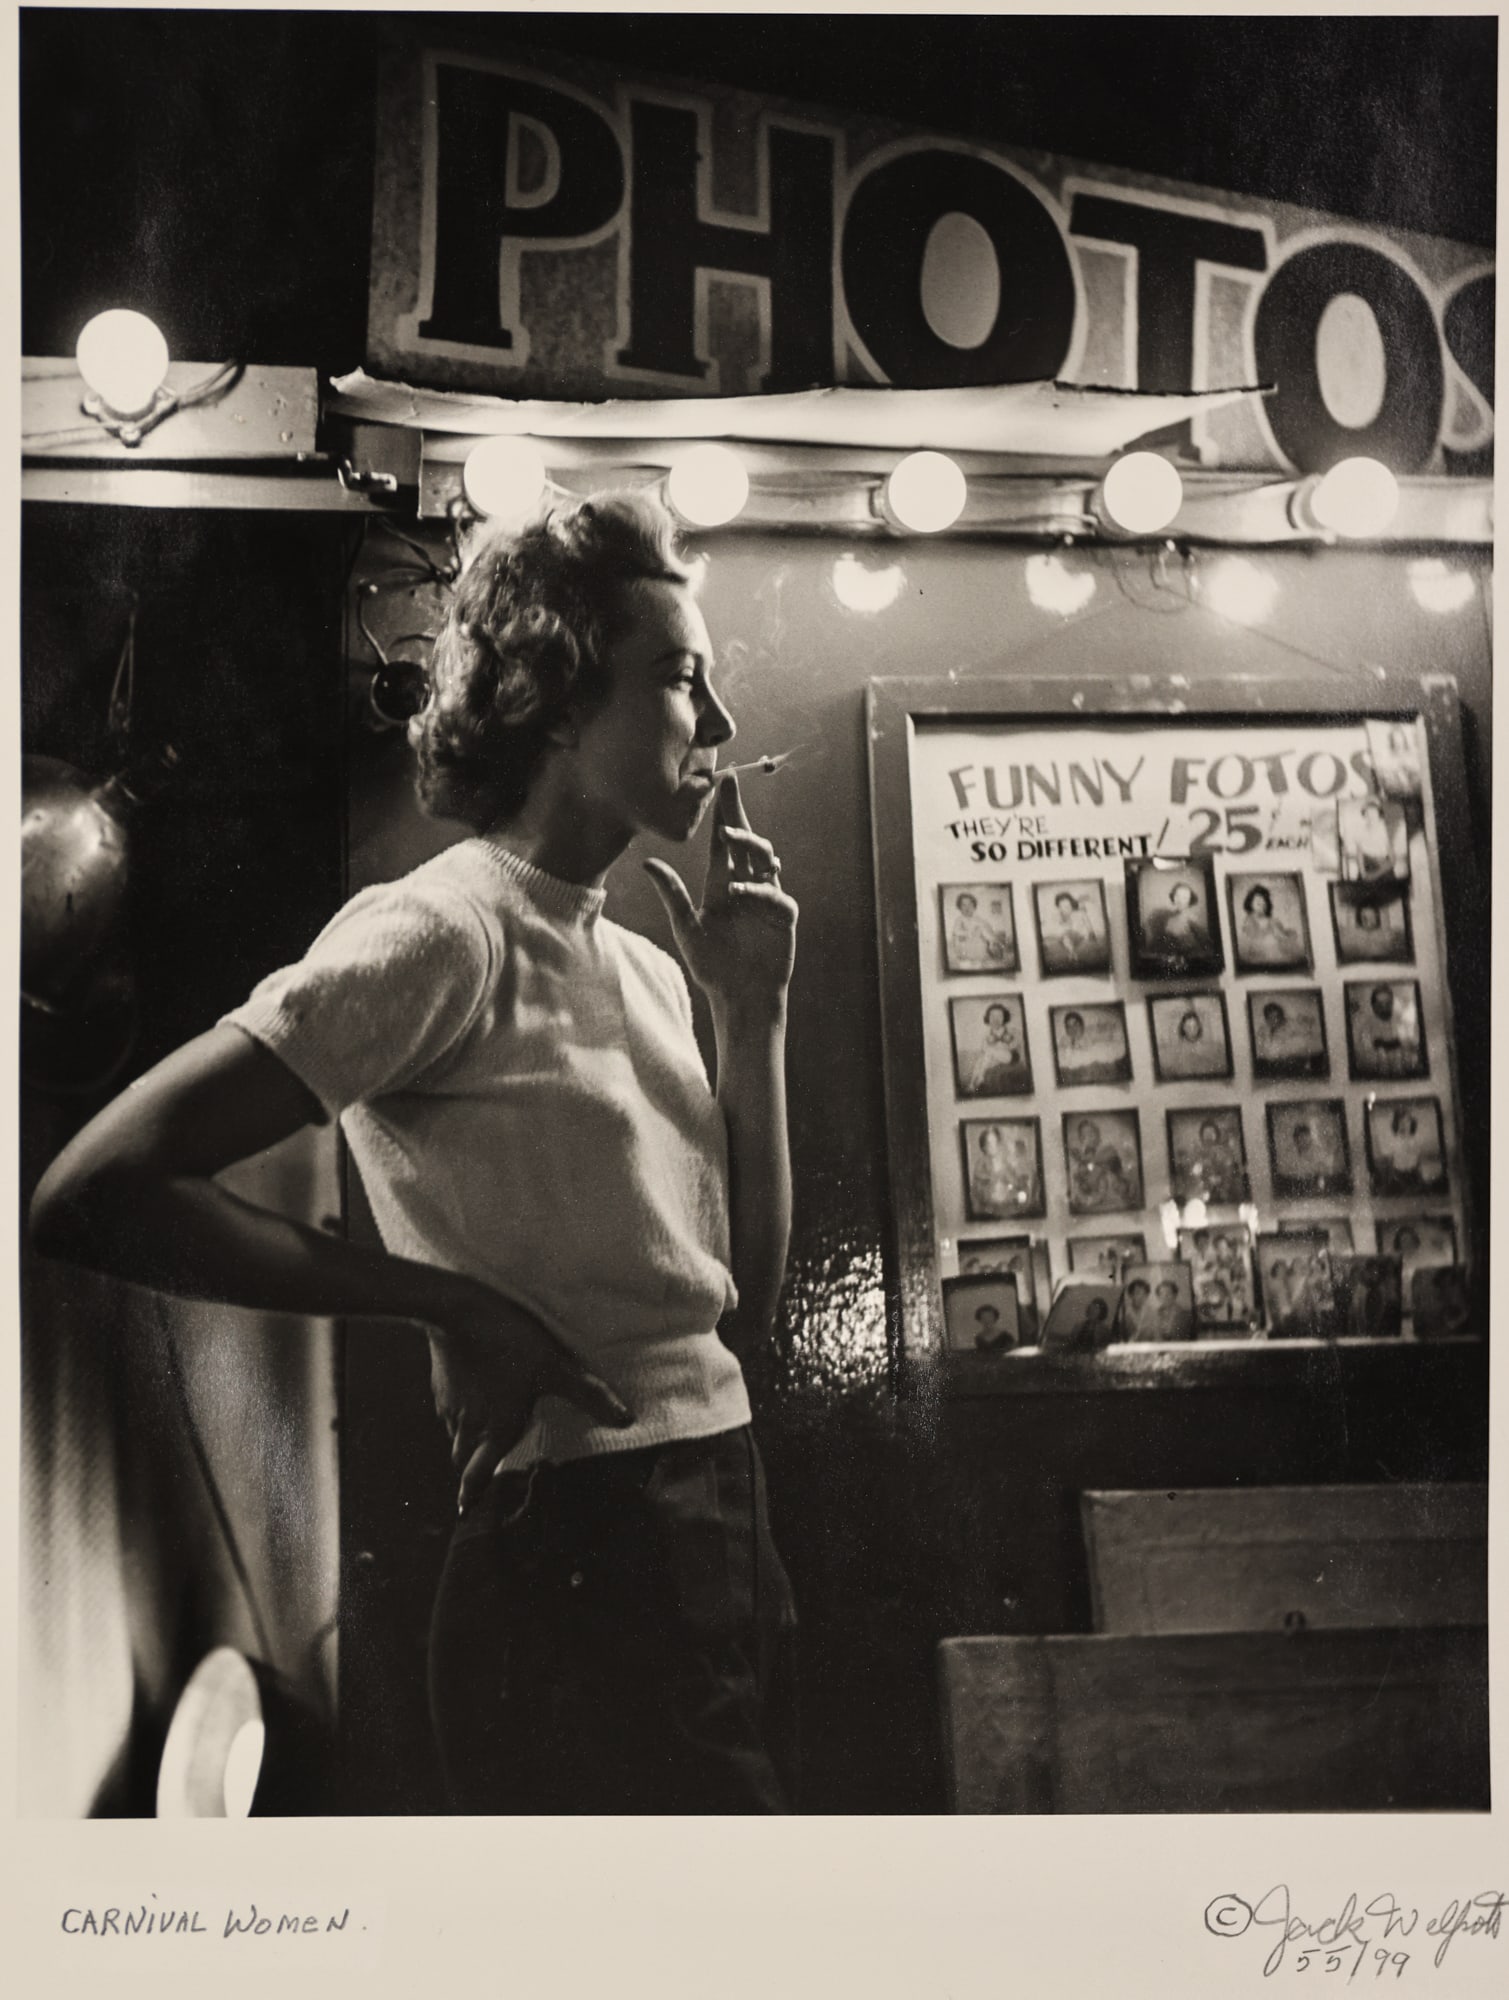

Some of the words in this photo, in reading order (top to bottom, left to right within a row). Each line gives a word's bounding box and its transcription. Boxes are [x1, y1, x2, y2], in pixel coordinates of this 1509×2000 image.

[948, 755, 1145, 809] FUNNY
[945, 813, 1050, 841] THEY'RE
[970, 840, 1008, 862] SO
[1297, 1941, 1411, 1984] 55/99
